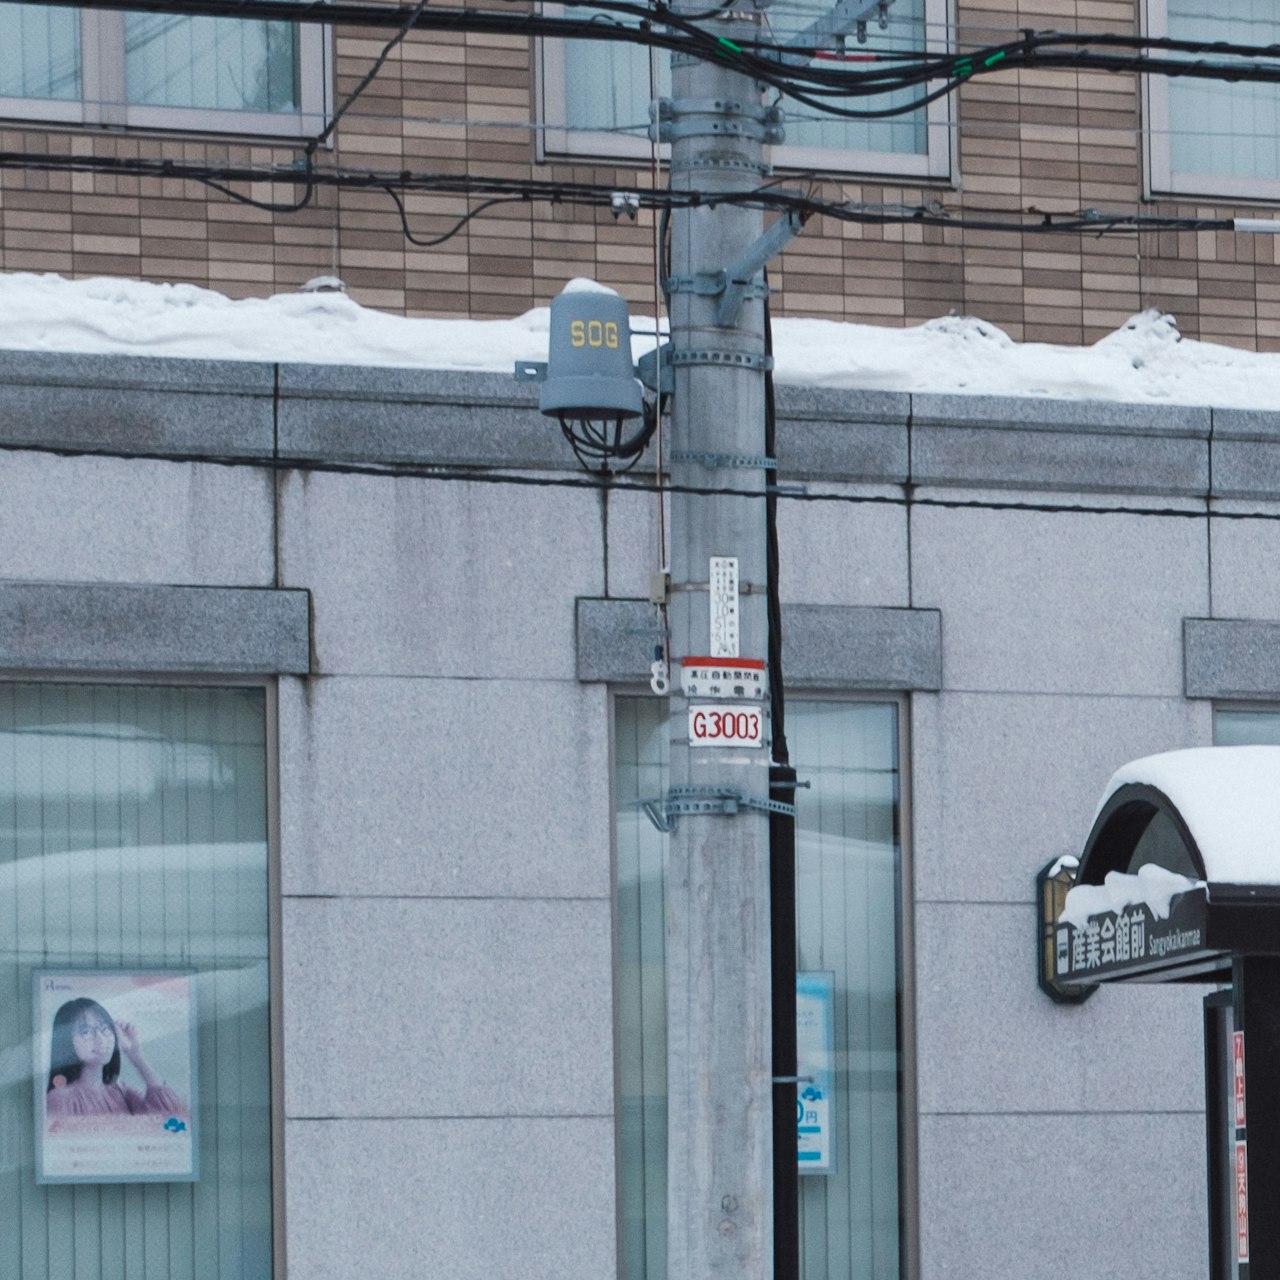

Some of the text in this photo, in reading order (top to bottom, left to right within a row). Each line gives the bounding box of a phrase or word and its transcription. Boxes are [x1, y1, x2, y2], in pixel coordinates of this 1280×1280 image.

[571, 320, 618, 349] SOG
[693, 711, 759, 740] G3003
[1072, 909, 1201, 971] 産業会館前 Sangyokaikanmae
